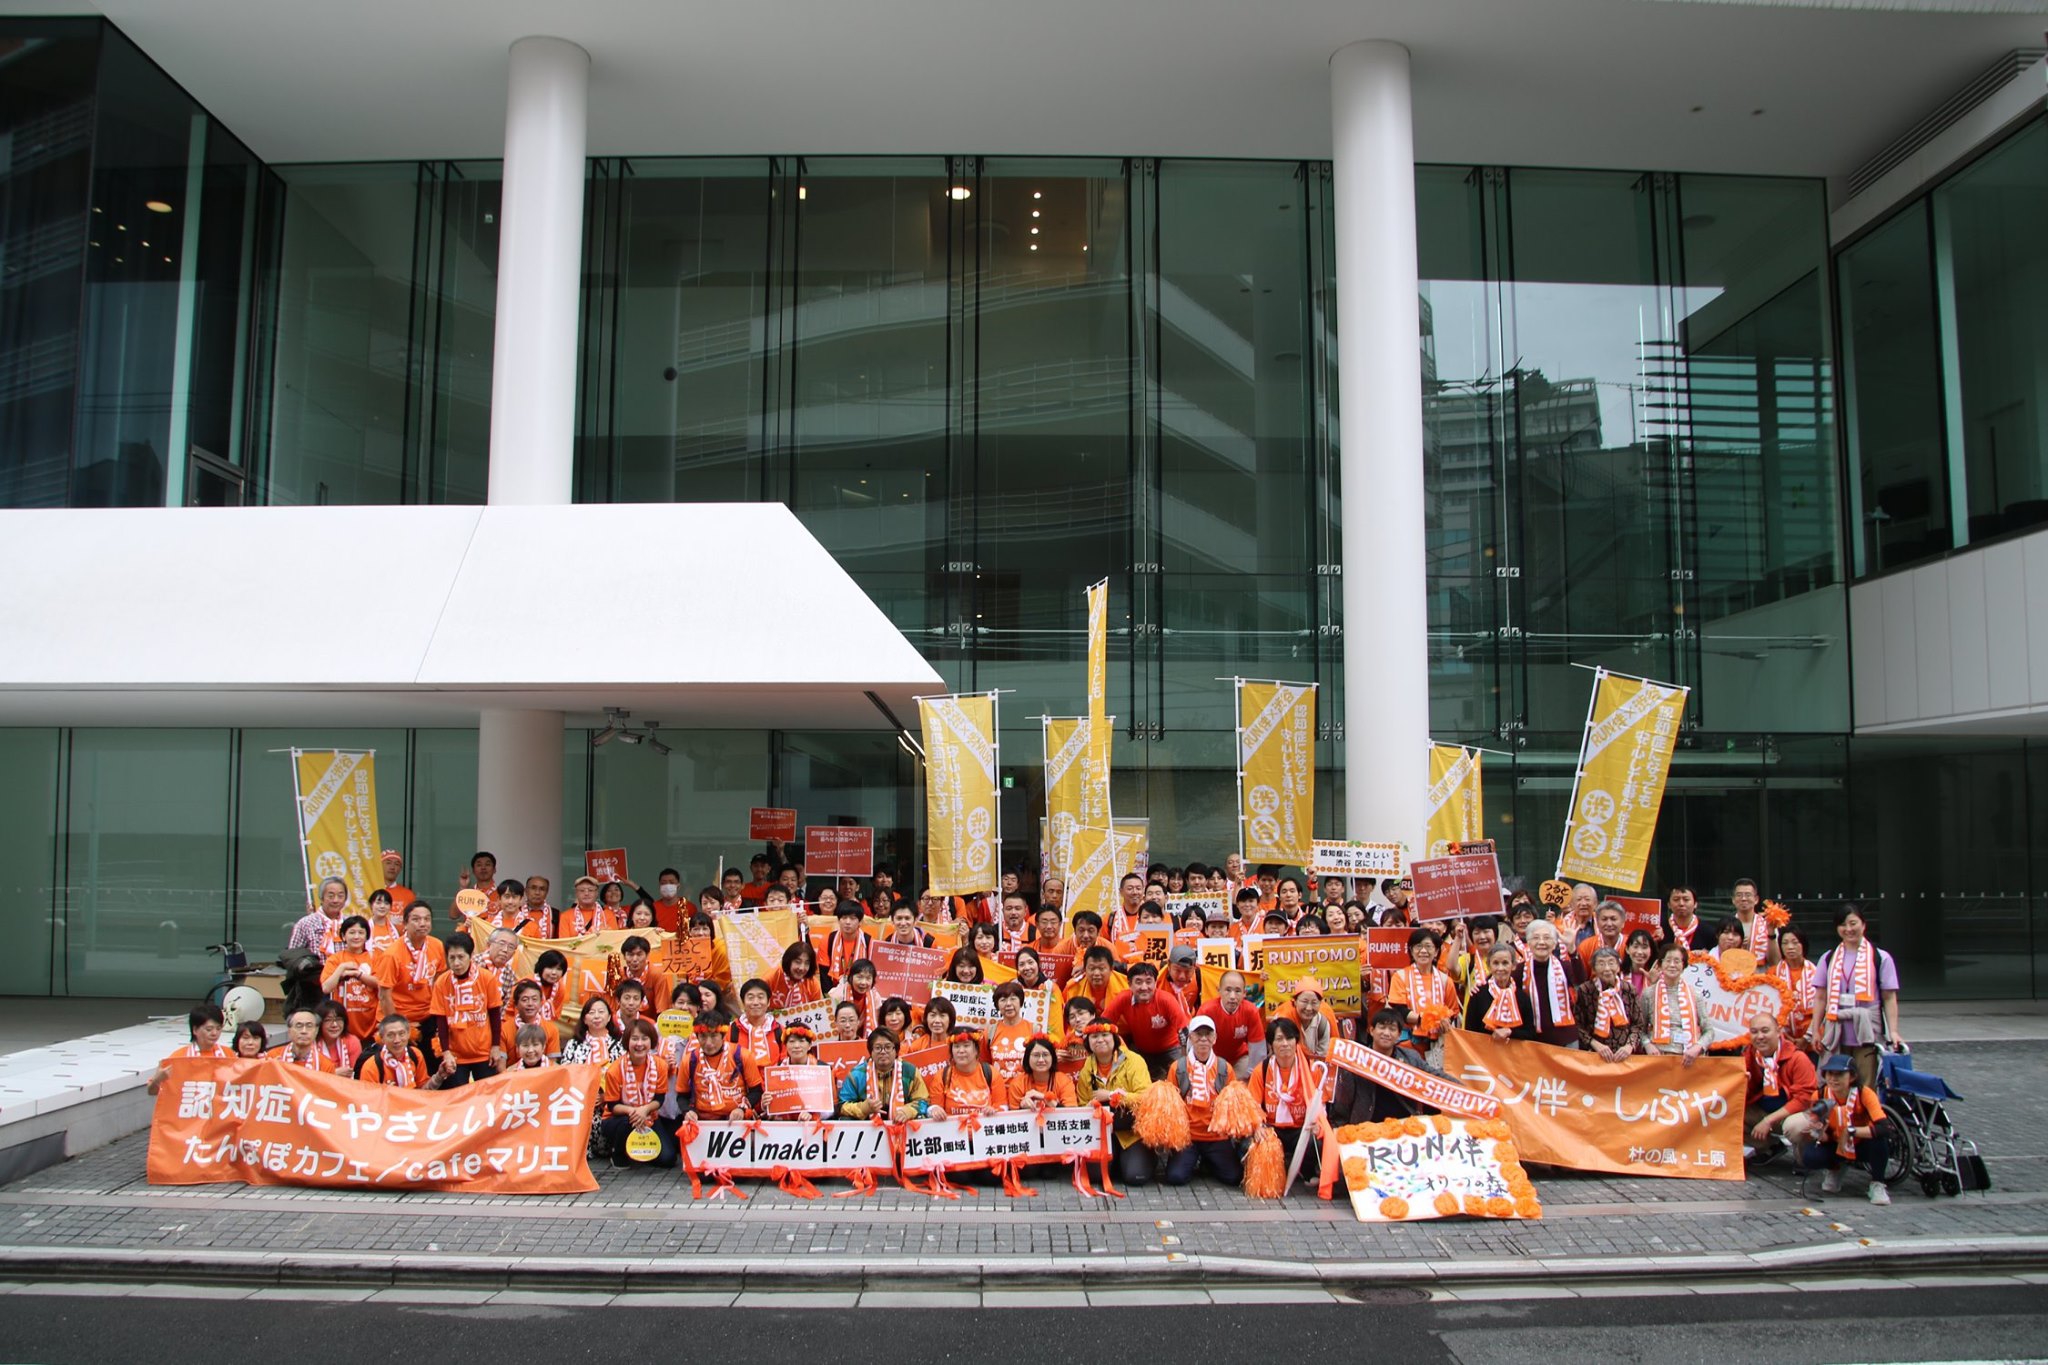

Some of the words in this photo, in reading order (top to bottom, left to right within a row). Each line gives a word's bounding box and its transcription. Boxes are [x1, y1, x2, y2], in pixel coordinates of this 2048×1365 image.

[1320, 849, 1352, 858] 認知症に
[1355, 850, 1390, 859] やさしい
[1544, 882, 1570, 897] つると
[457, 896, 476, 906] RUN
[1544, 893, 1564, 904] かめ
[1143, 937, 1168, 962] 認
[1268, 947, 1357, 965] RUNTOMO
[1368, 942, 1401, 954] RUN伴
[661, 957, 712, 974] ステーション
[1276, 976, 1352, 994] SHUYA
[1332, 1039, 1500, 1117] RUNTOMO+SHIBUYA
[1460, 1064, 1729, 1127] ラン伴・しぶや
[178, 1080, 585, 1144] 認知症にやさしい渋谷
[1045, 1118, 1092, 1131] 包括支援
[706, 1130, 746, 1159] We
[758, 1138, 820, 1161] make
[1061, 1134, 1102, 1146] センター
[984, 1141, 1031, 1157] 本町地域
[1367, 1133, 1484, 1173] RUN伴
[1628, 1145, 1727, 1168] 杜の風・上原
